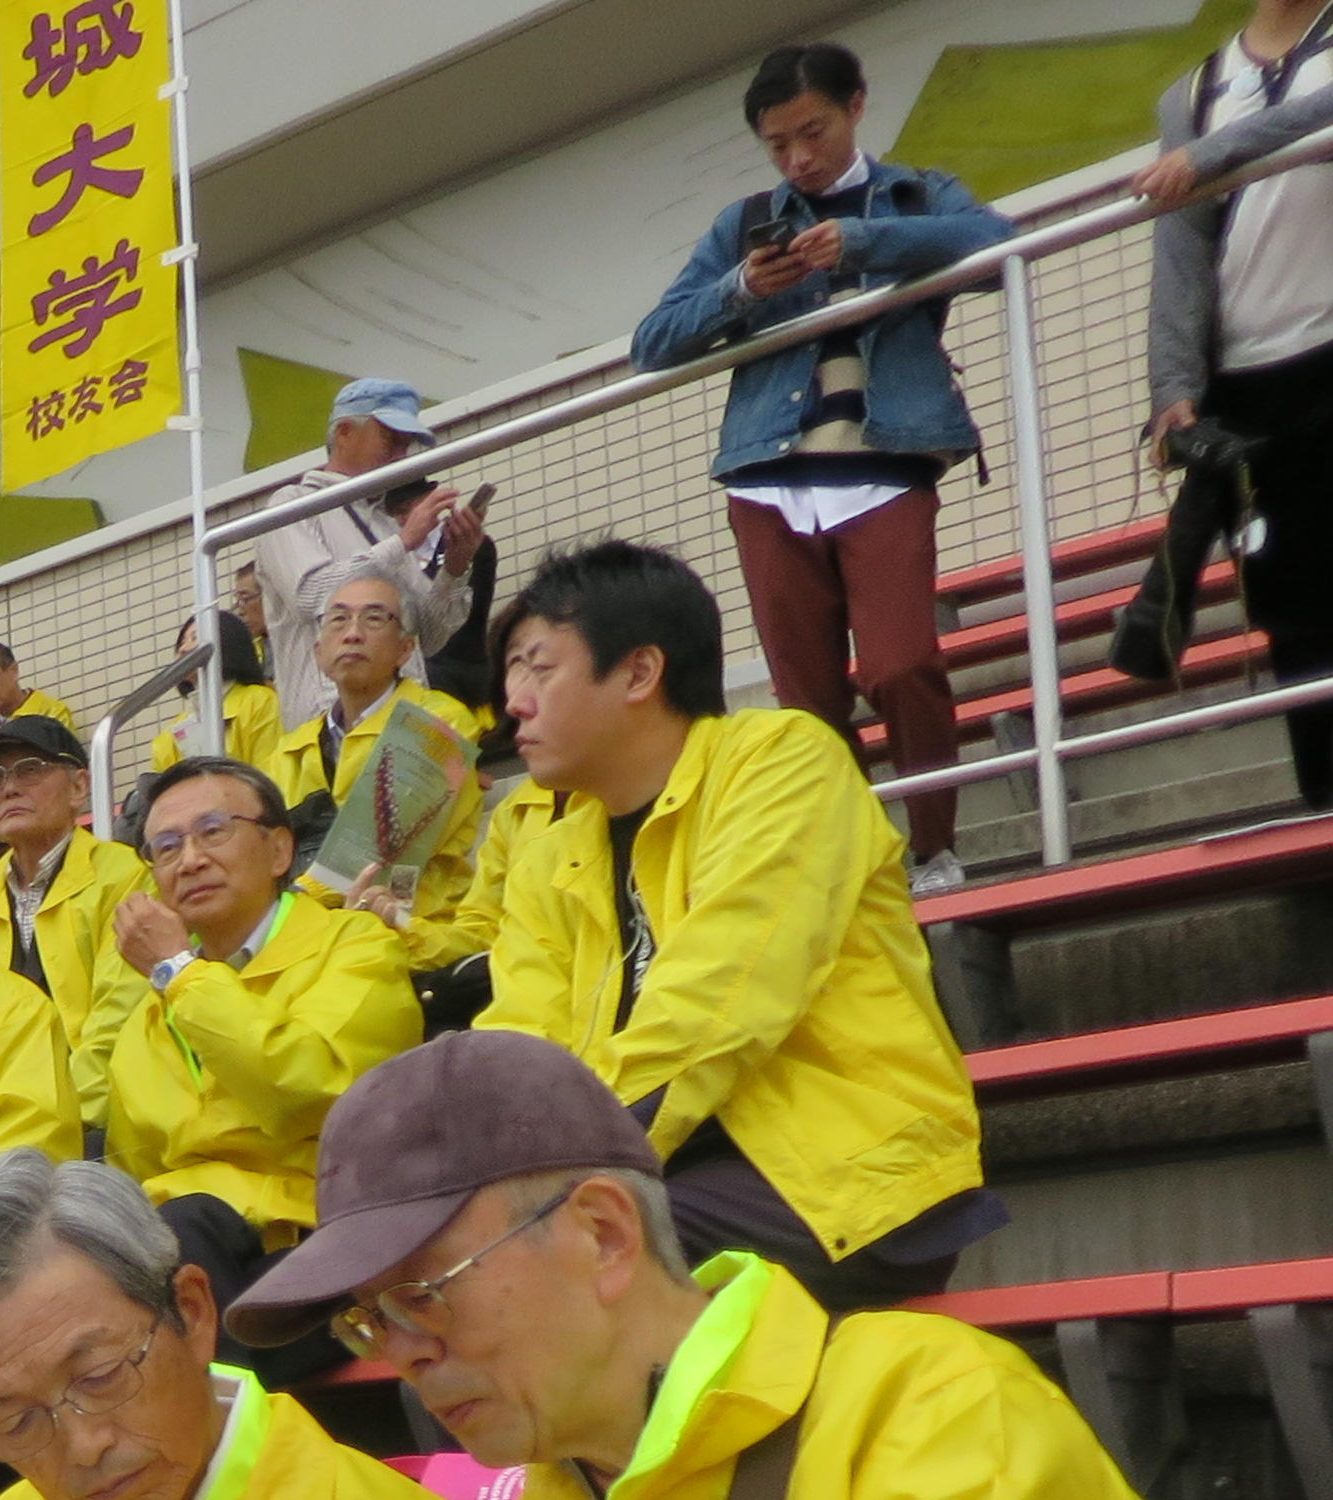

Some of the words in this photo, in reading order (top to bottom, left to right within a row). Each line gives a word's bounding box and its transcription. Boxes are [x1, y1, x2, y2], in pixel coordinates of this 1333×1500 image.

[22, 0, 146, 360] 城大学
[24, 358, 149, 443] 校友会
